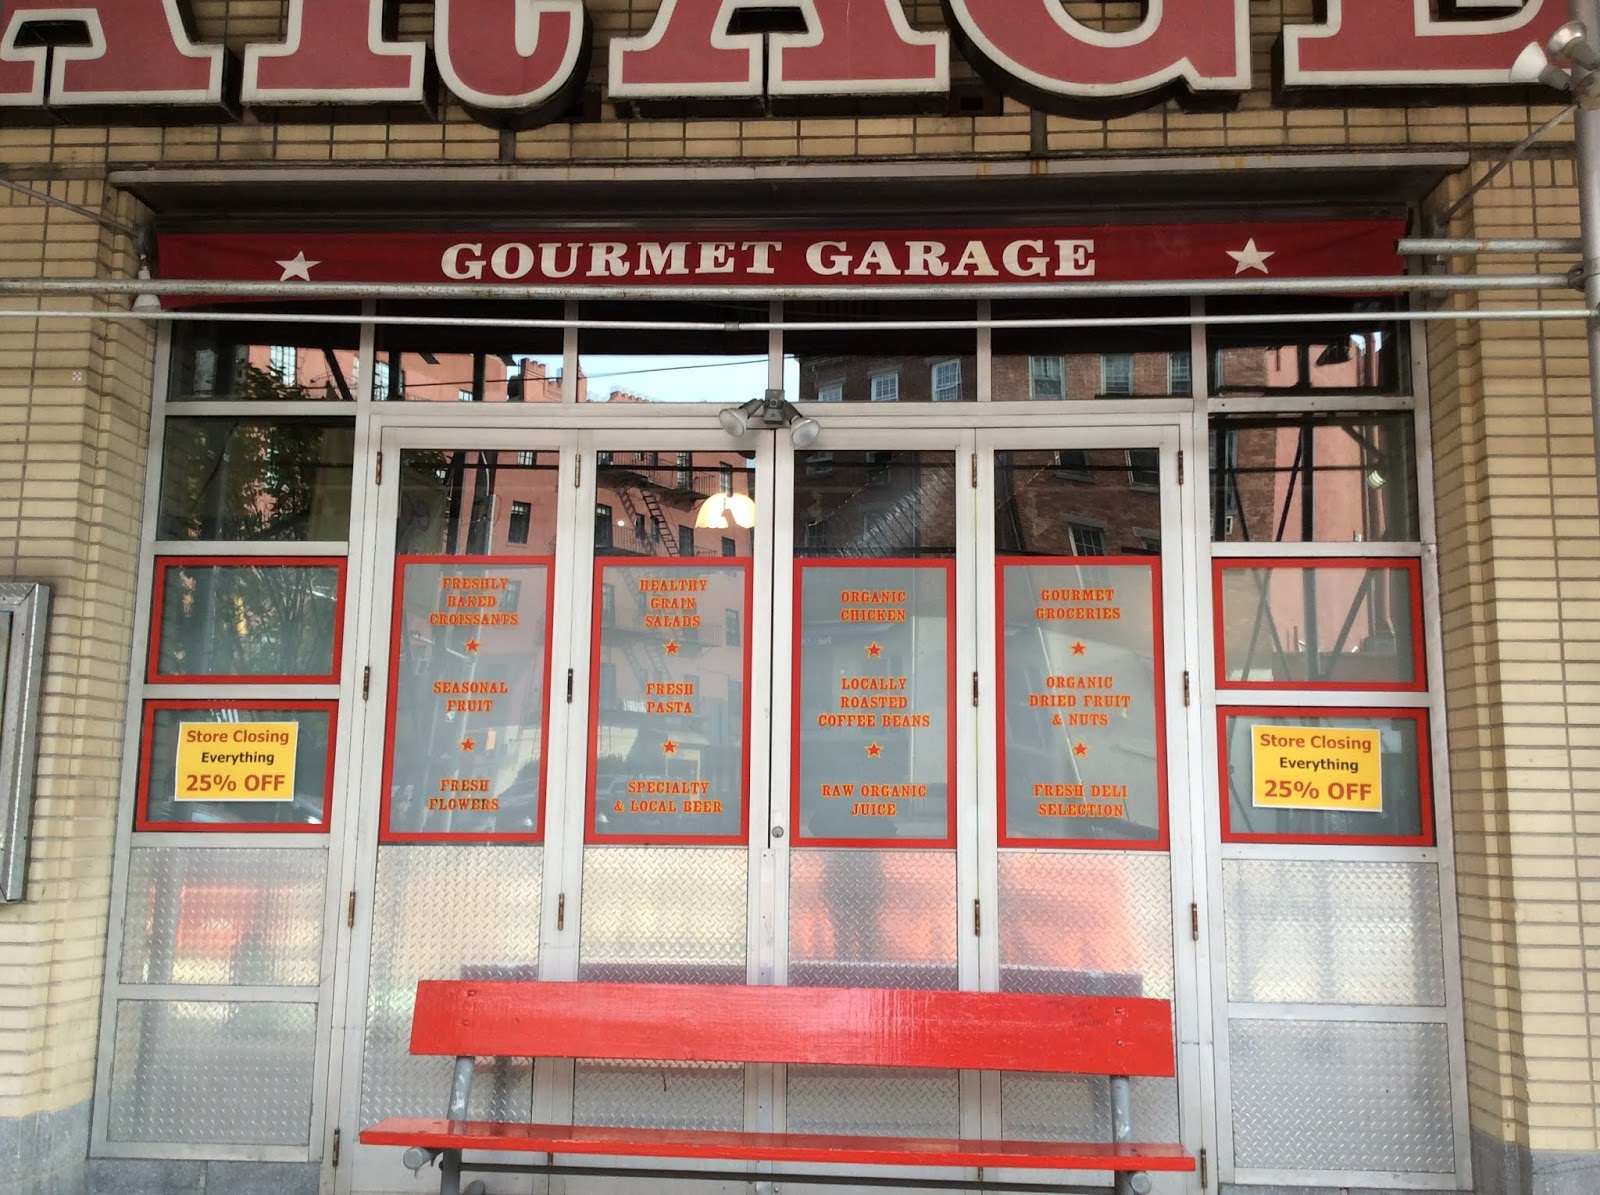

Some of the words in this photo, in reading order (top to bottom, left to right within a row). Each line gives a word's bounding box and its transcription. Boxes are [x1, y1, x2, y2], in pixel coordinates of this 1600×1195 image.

[440, 241, 783, 280] GOURMET
[805, 238, 1096, 277] GARAGE
[442, 578, 509, 590] FRESHLY
[640, 579, 707, 592] HEALTHY
[841, 591, 906, 603] ORGANIC
[1041, 589, 1114, 601] GOURMET
[447, 596, 497, 608] BAKED
[651, 598, 695, 609] GRAIN
[429, 613, 518, 626] CROISSANTS
[840, 609, 906, 622] CHICKEN
[1036, 607, 1121, 620] GROCERIES
[645, 615, 700, 628] SALADS
[433, 681, 508, 694] SEASONAL
[841, 678, 907, 690] LOCALLY
[1046, 676, 1113, 688] ORGANIC
[646, 683, 694, 695] FRESH
[447, 700, 493, 712] FRUIT
[840, 696, 908, 709] ROASTED
[1029, 694, 1077, 708] DRIED
[1083, 695, 1131, 708] FRUIT
[646, 702, 693, 714] PASTA
[818, 715, 876, 727] COFFEE
[882, 714, 930, 728] BEANS
[1052, 715, 1062, 726] &
[1068, 714, 1108, 726] NUTS
[186, 730, 228, 742] Store
[233, 730, 289, 745] Closing
[1260, 734, 1305, 747] Store
[1311, 735, 1371, 753] Closing
[202, 752, 274, 765] Everything
[1280, 757, 1359, 773] Everything
[186, 775, 236, 791] 25%
[244, 775, 285, 791] OFF
[440, 780, 489, 791] FRESH
[628, 781, 709, 794] SPECIALTY
[822, 784, 854, 797] RAW
[861, 784, 926, 798] ORGANIC
[1033, 785, 1084, 798] FRESH
[1091, 785, 1128, 798] DELI
[1265, 780, 1319, 799] 25%
[1328, 783, 1371, 800] OFF
[429, 798, 499, 811] FLOWERS
[614, 801, 624, 812] &
[630, 800, 676, 812] LOCAL
[683, 801, 722, 812] BEER
[852, 803, 896, 816] JUICE
[1038, 803, 1123, 817] SELECTION
